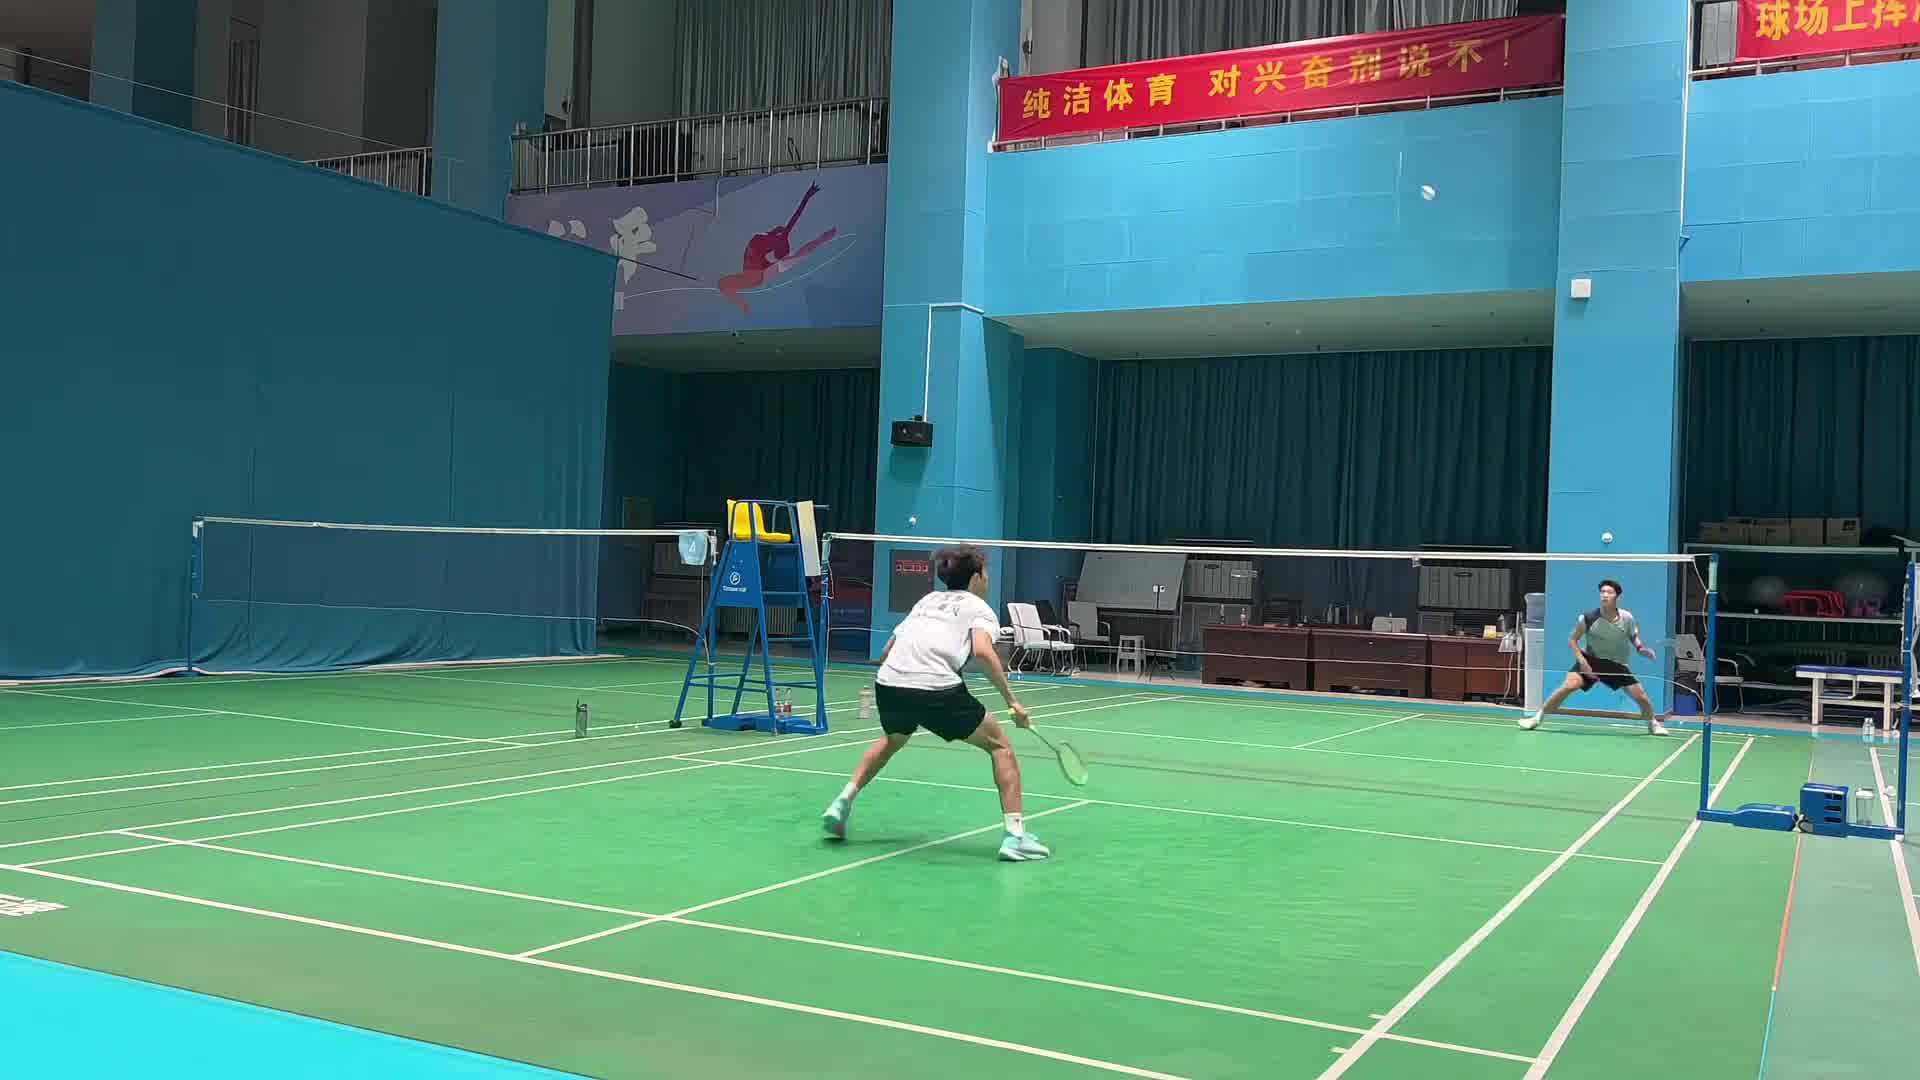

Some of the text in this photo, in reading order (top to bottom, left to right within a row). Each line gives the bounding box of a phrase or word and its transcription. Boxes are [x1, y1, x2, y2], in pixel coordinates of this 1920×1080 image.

[1756, 0, 1920, 40] 球场上挥
[1022, 73, 1178, 119] 纯洁体育
